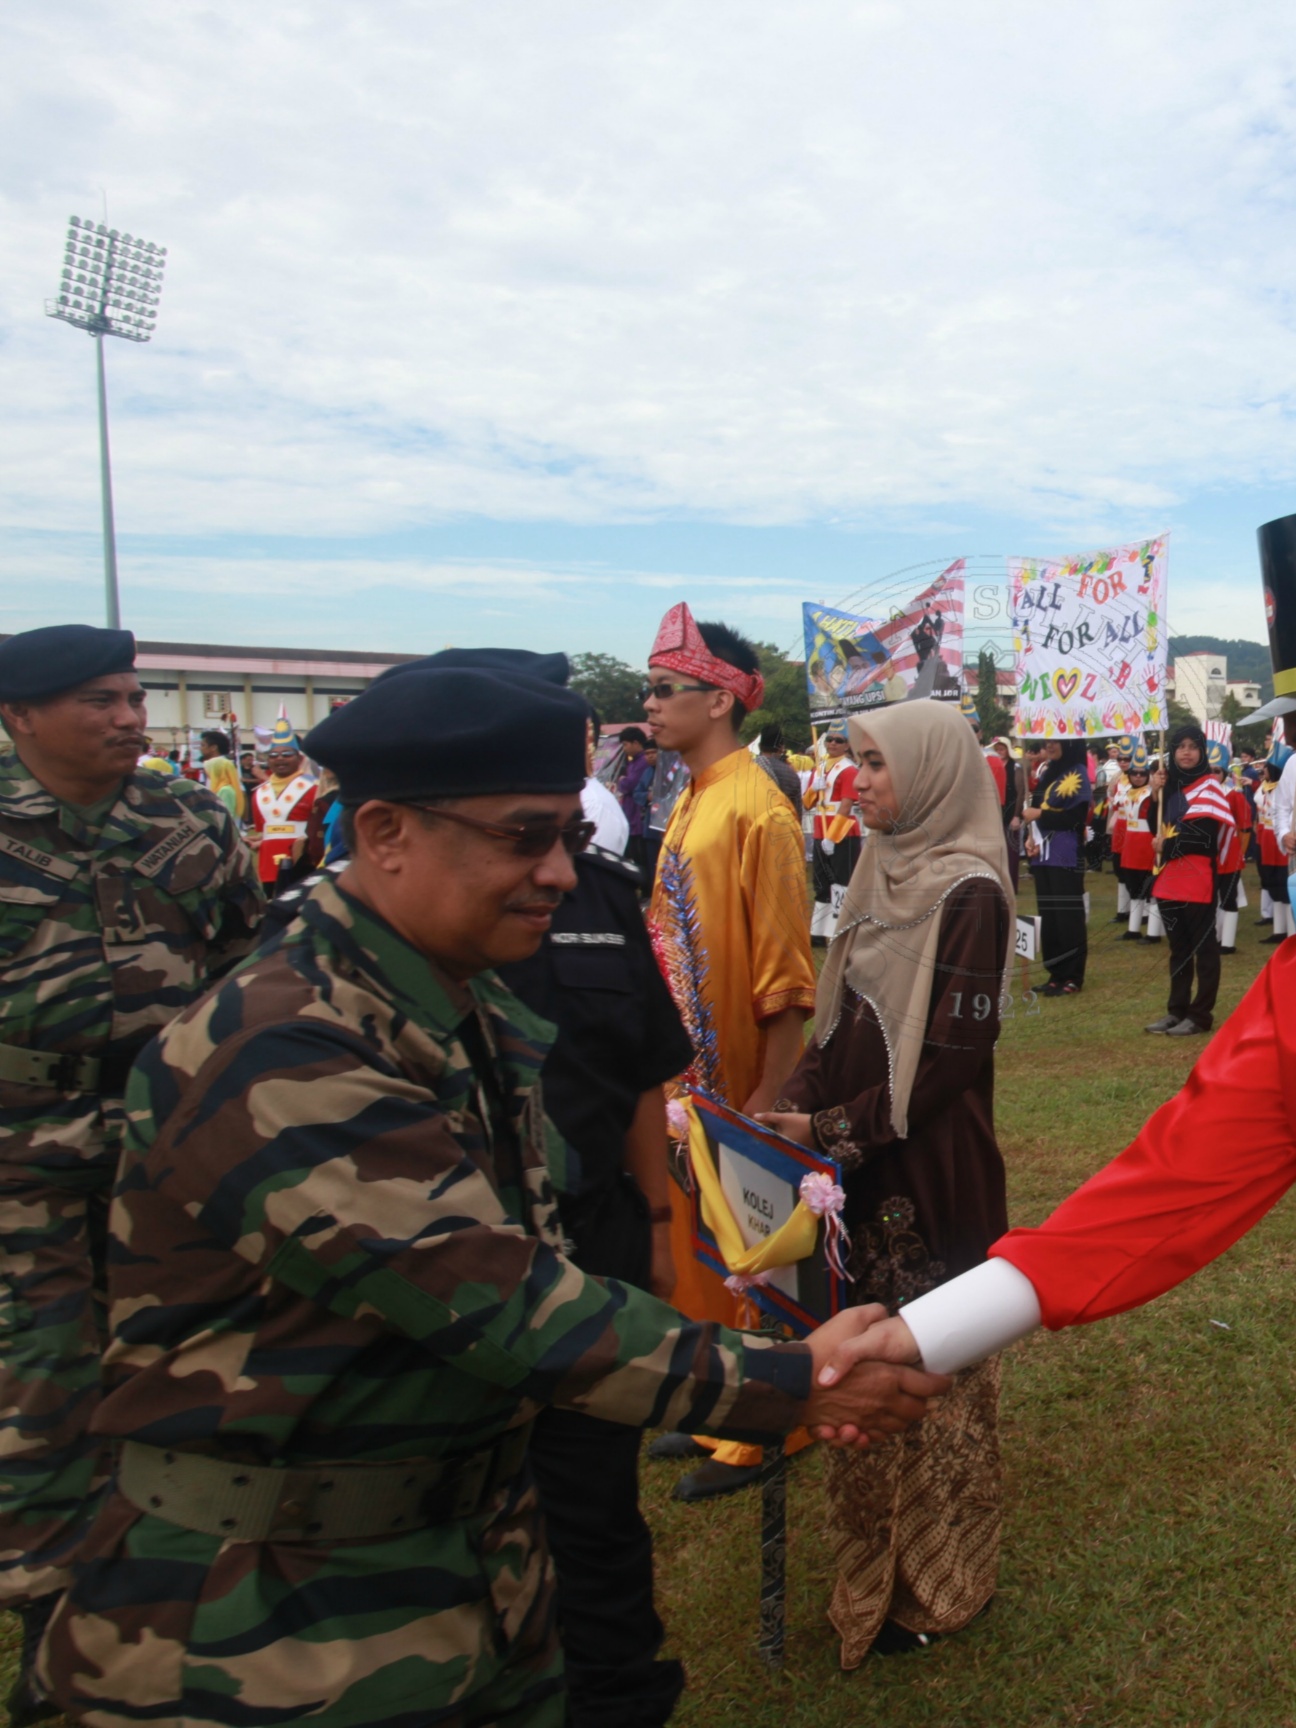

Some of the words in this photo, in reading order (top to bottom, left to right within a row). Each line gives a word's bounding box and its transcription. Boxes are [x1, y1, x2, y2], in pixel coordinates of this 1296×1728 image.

[1020, 583, 1062, 612] ALL
[1076, 570, 1127, 605] FOR
[1041, 621, 1094, 655] FOR
[1104, 611, 1145, 648] ALL
[1021, 671, 1052, 701] WE
[6, 839, 52, 867] TALIB
[142, 825, 195, 870] WATANIAH
[1015, 929, 1028, 952] 25
[742, 1187, 774, 1220] KOLEJ
